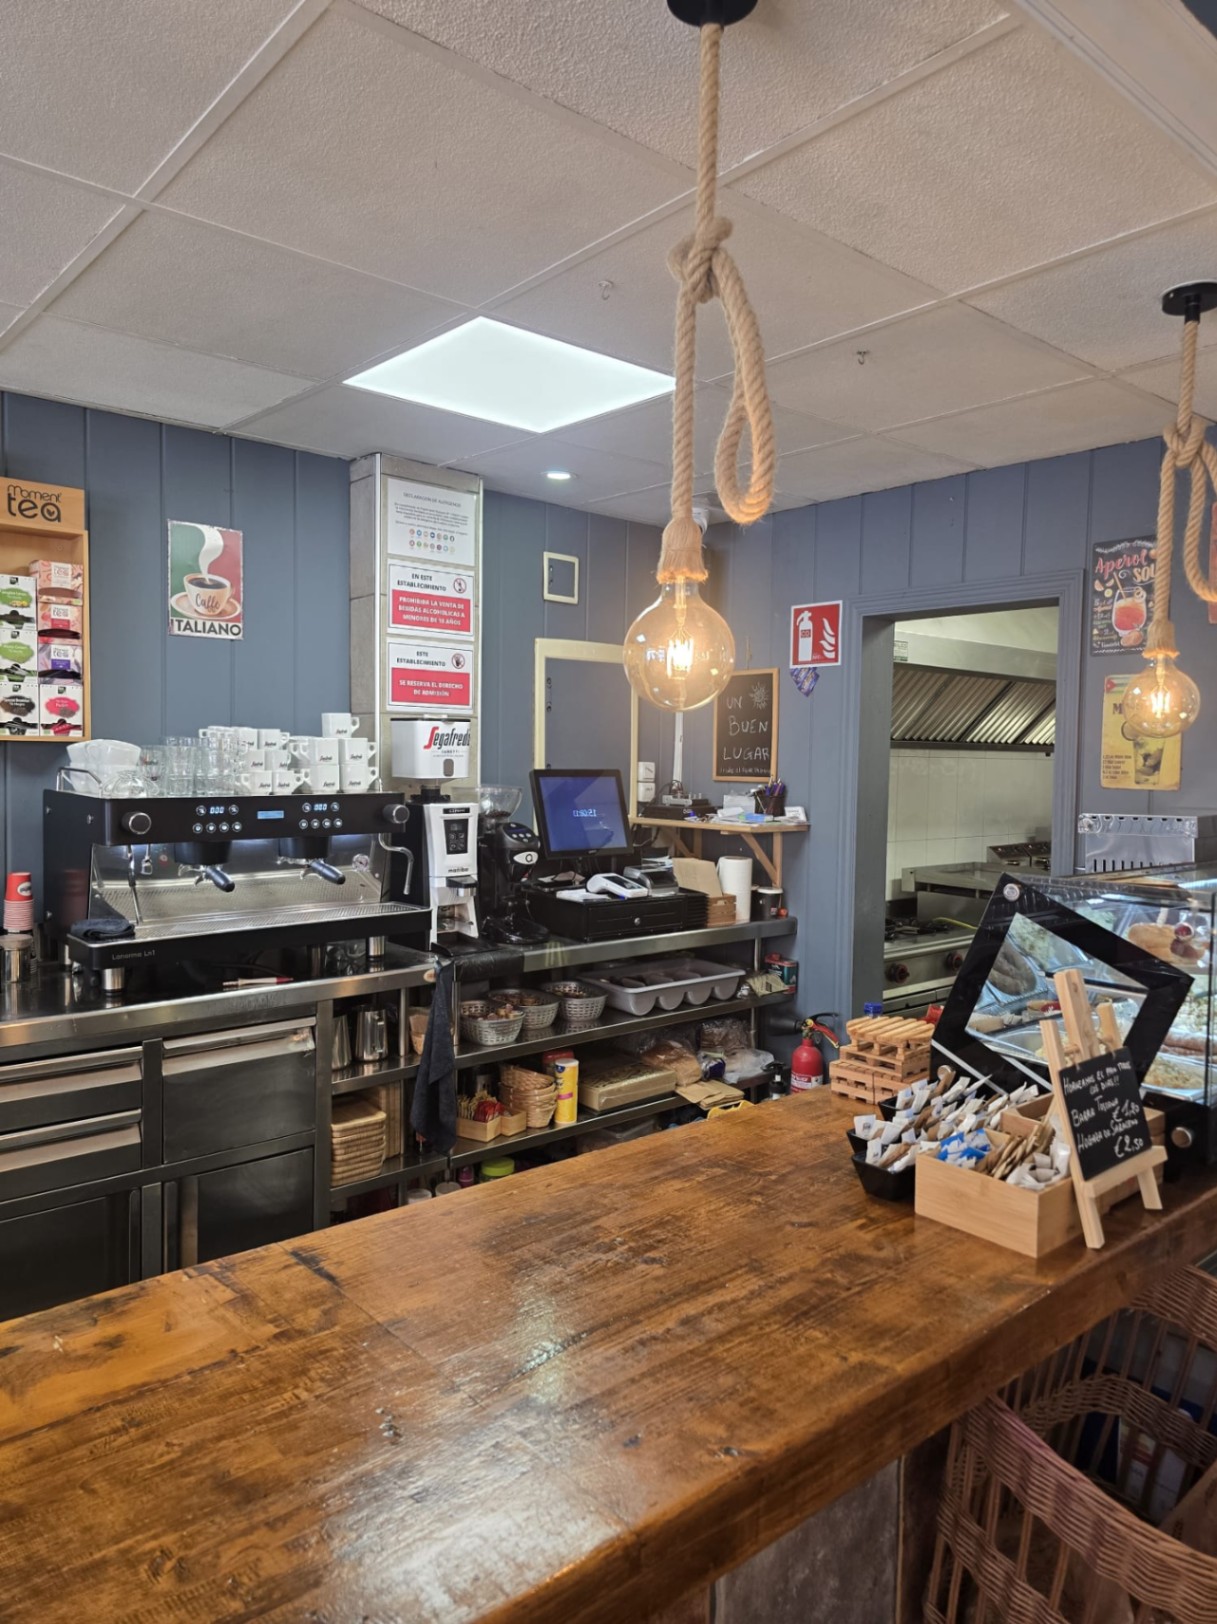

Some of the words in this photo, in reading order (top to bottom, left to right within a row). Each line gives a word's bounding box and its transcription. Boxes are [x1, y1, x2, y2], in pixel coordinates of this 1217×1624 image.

[8, 493, 61, 522] tea
[1095, 548, 1148, 580] Aperol
[397, 579, 447, 592] ESTABLECIMIENTO
[170, 618, 242, 636] ITALIANO
[396, 657, 446, 667] ESTABLECIMIENTO
[727, 696, 742, 709] UN
[728, 715, 768, 736] BUEN
[723, 747, 770, 760] LUGAR
